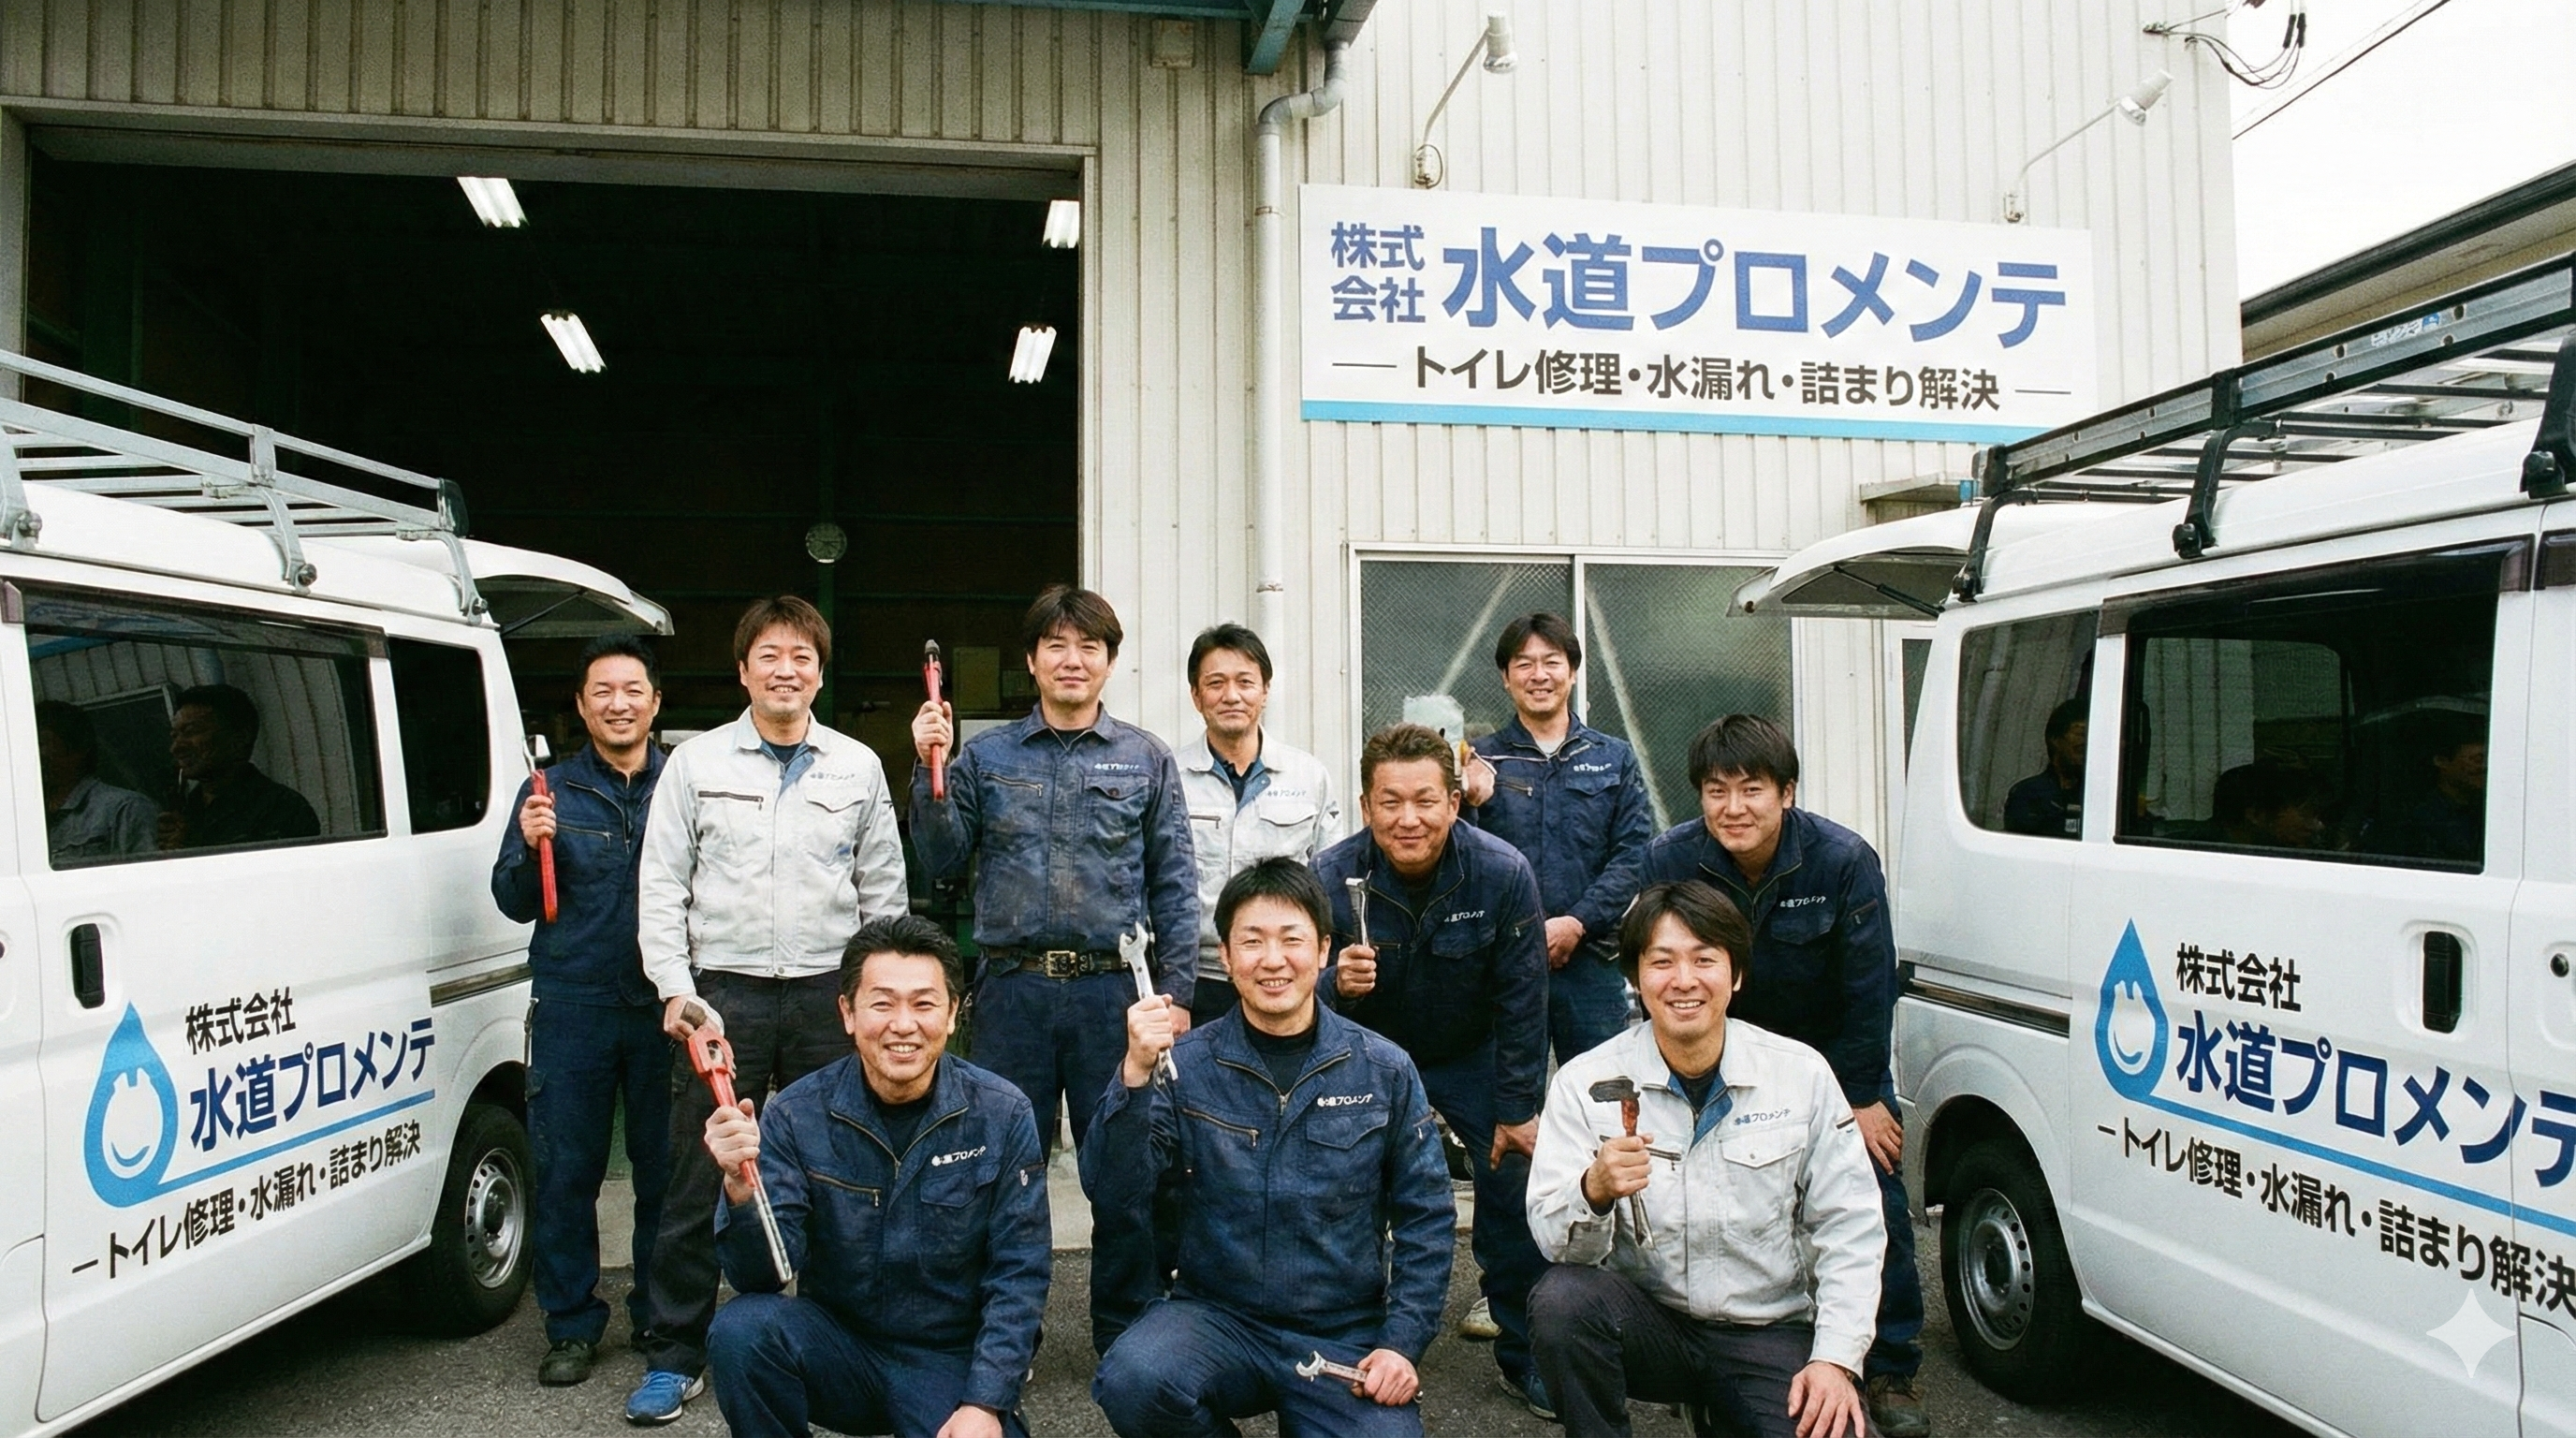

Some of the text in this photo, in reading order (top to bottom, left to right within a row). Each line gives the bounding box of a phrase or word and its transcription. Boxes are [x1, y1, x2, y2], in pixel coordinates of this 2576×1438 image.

[1331, 222, 1426, 272] 株式
[1331, 276, 1426, 324] 会社
[1442, 227, 2067, 349] 水道プロメンテ
[2175, 942, 2302, 1013] 株式会社
[185, 987, 297, 1056] 株式会社
[190, 1017, 436, 1153] 水道プロメンテ
[2175, 1009, 2576, 1188] 水道プロメンテ
